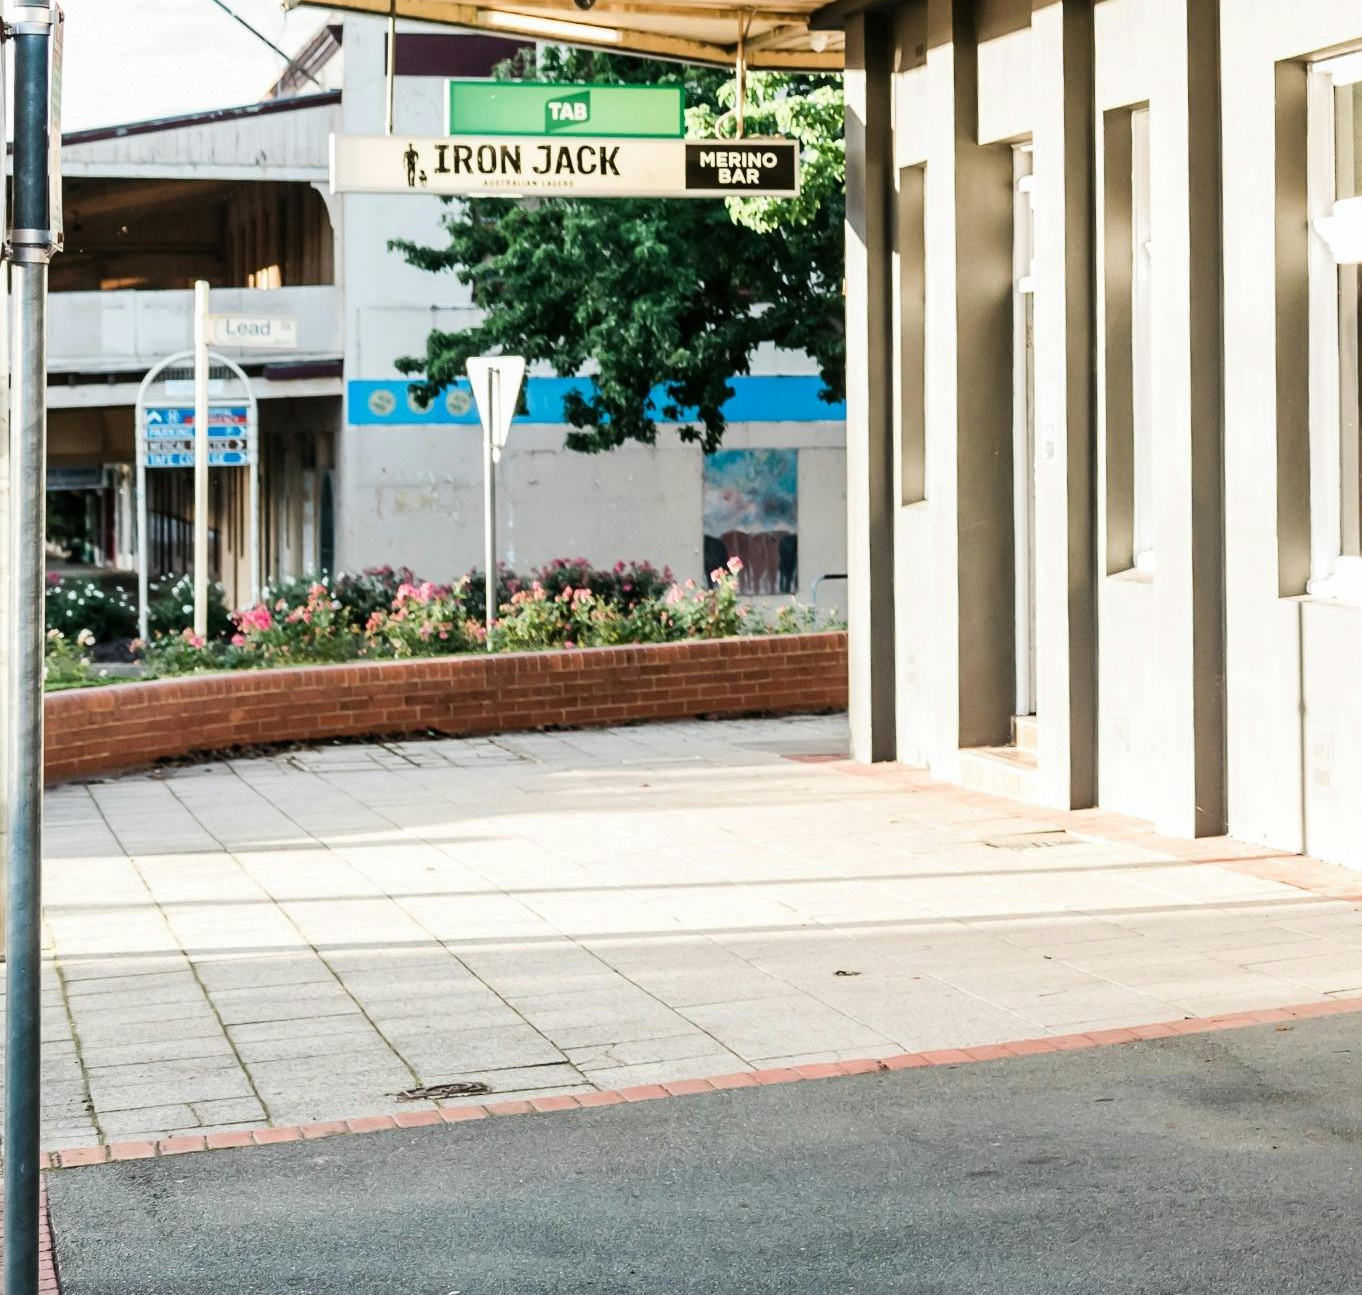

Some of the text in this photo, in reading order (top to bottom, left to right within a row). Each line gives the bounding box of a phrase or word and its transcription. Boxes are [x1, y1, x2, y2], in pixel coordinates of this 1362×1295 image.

[548, 101, 588, 121] TAB
[434, 144, 621, 176] IRON JACK
[700, 151, 778, 169] MERINO
[718, 168, 760, 185] BAR
[226, 318, 271, 337] Lead
